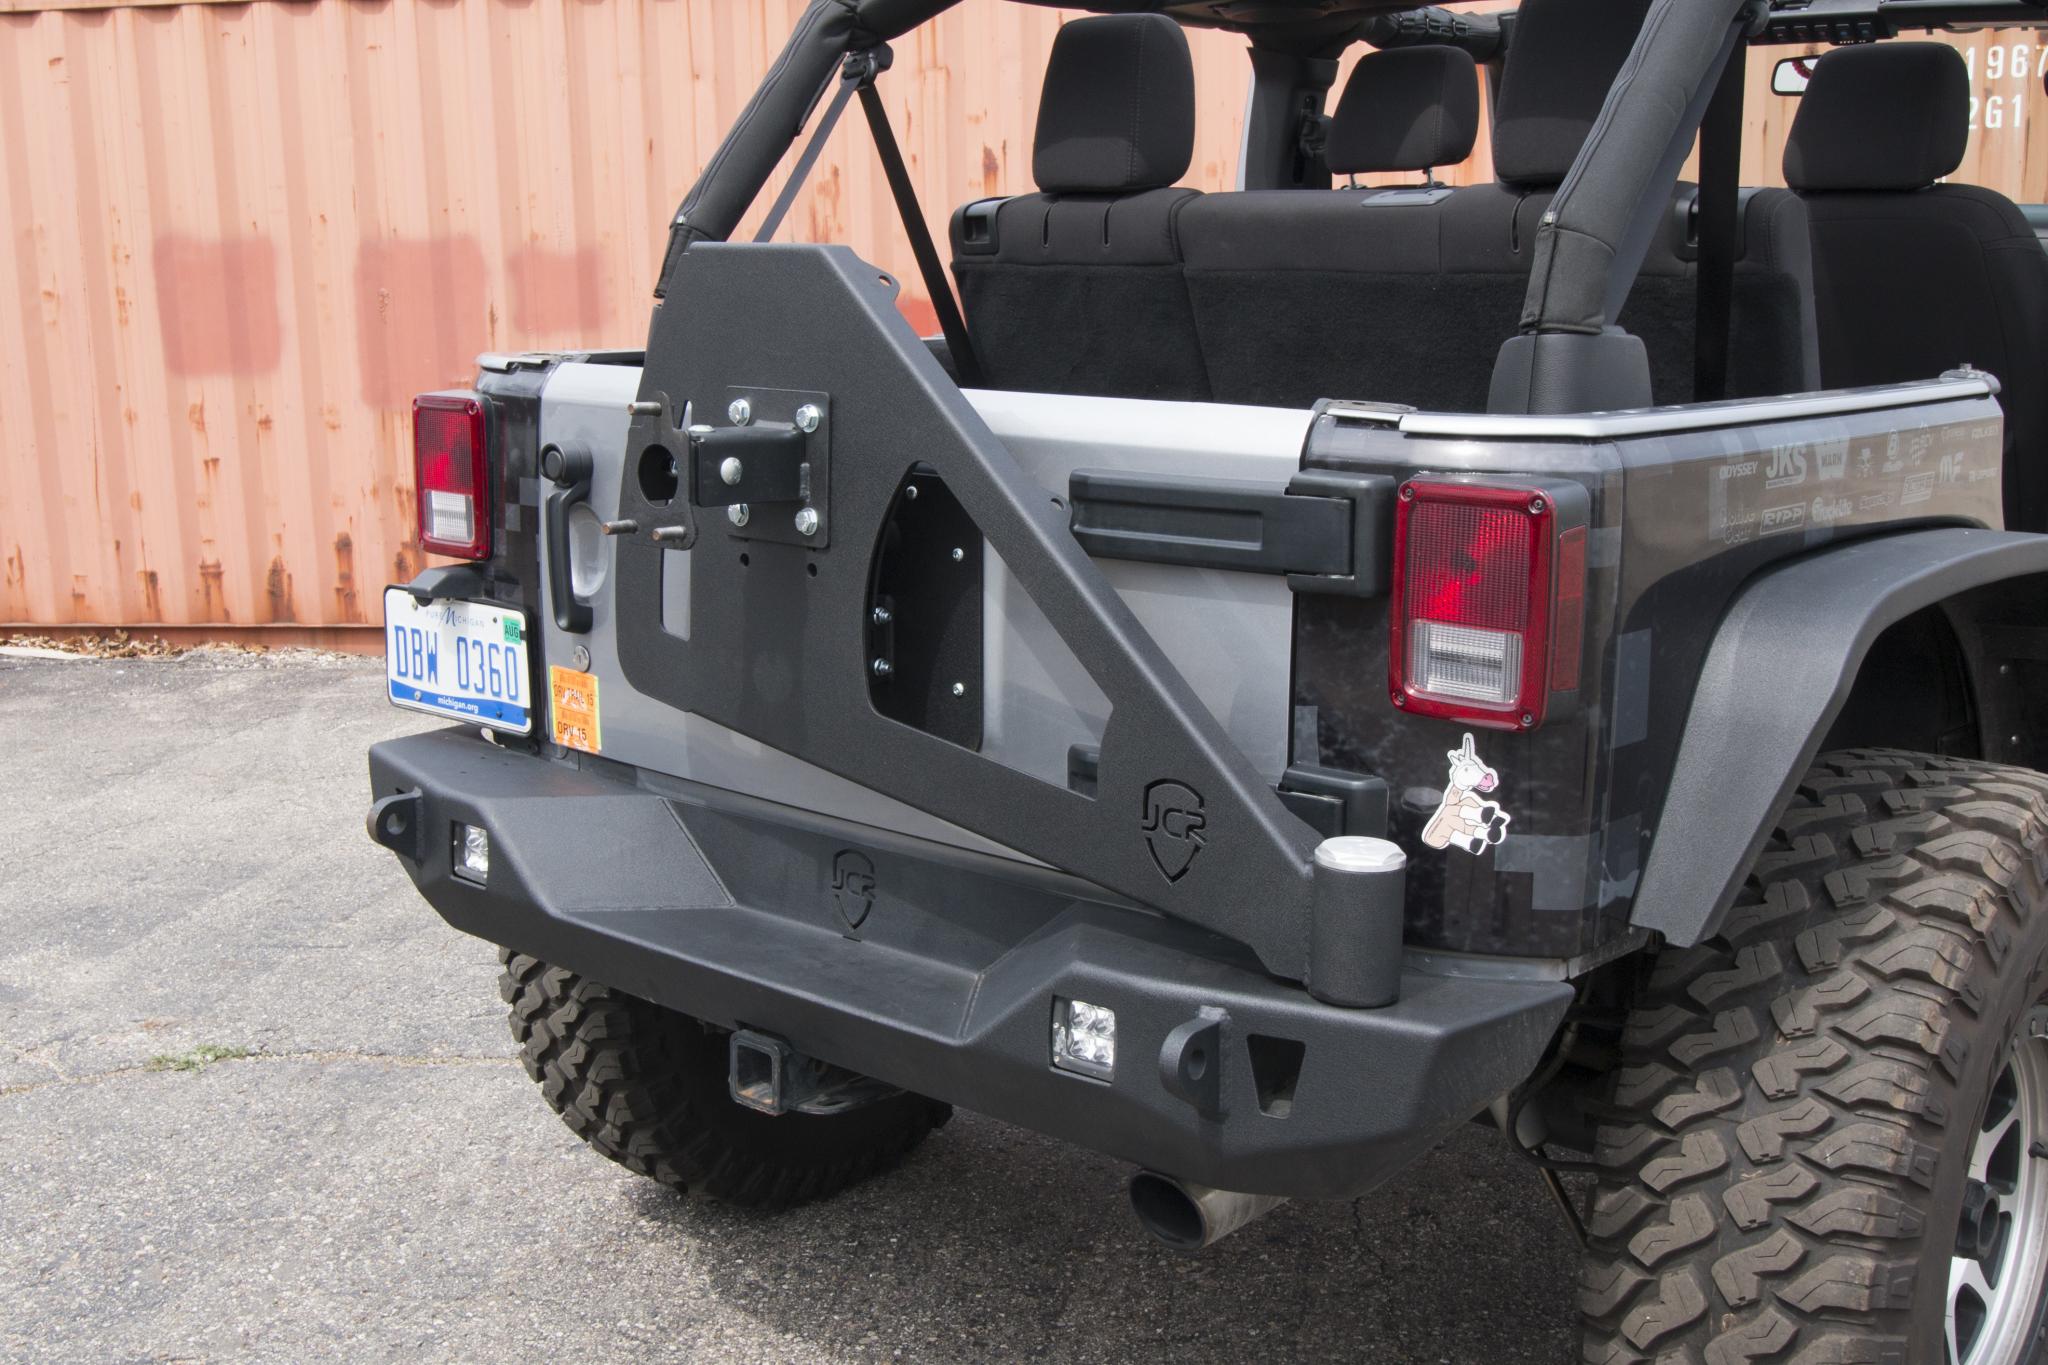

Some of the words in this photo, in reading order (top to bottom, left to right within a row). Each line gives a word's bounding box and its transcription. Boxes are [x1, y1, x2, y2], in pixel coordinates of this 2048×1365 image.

[1956, 44, 2048, 80] 1967
[1719, 461, 1759, 479] ODYSSEY
[1766, 444, 1807, 484] JKS
[504, 624, 520, 639] AUG
[394, 625, 439, 685] DBW
[457, 636, 519, 701] 0360
[437, 696, 479, 714] michigan.org
[577, 728, 587, 741] 15
[1141, 804, 1207, 845] JCR
[832, 868, 877, 901] JCR
